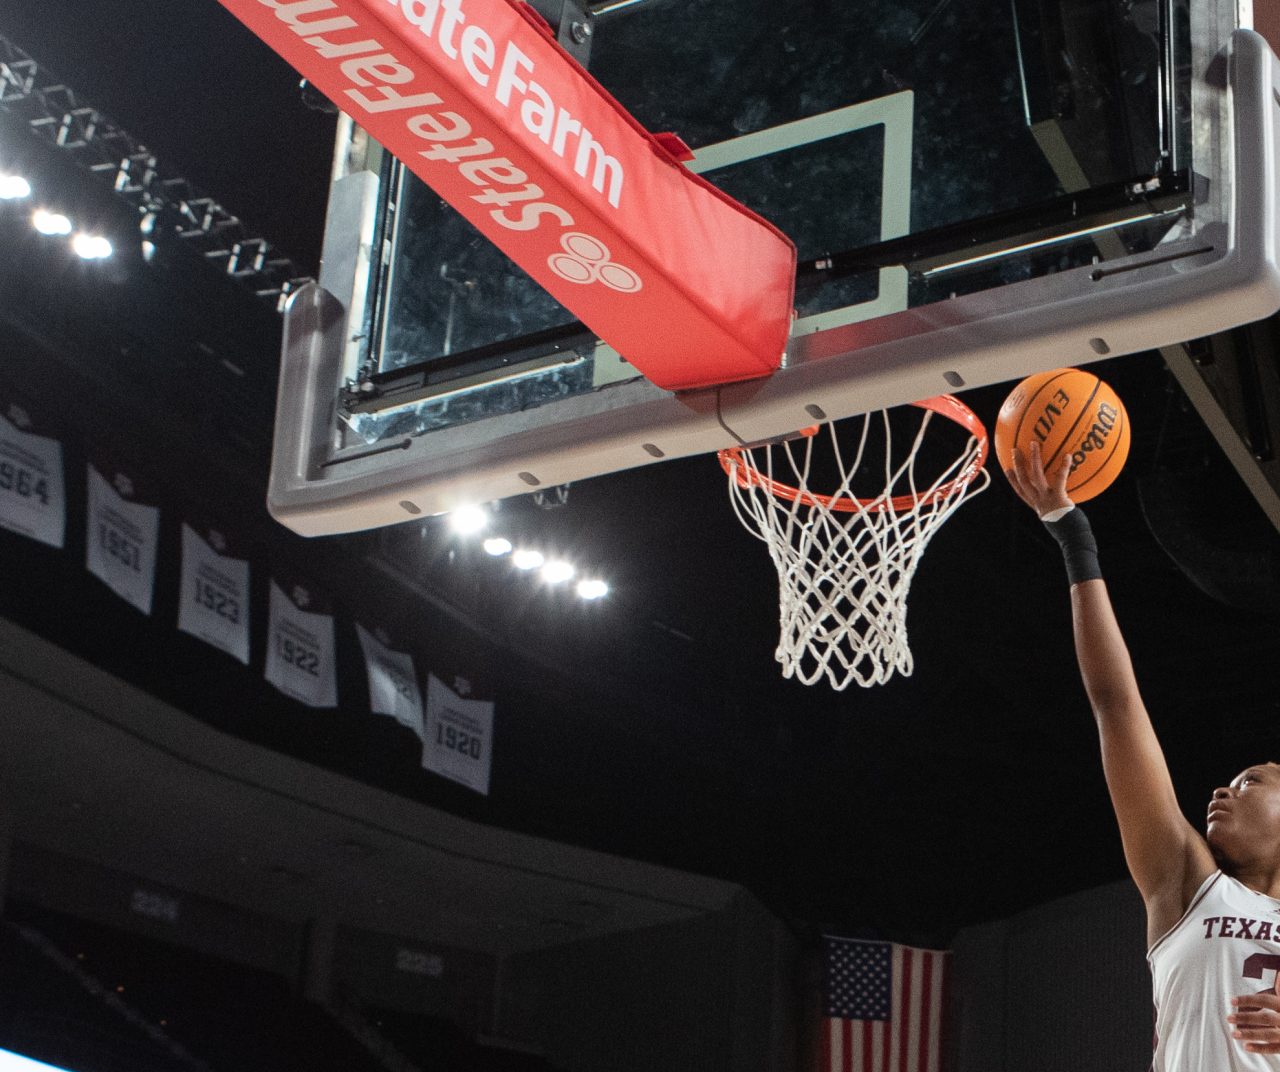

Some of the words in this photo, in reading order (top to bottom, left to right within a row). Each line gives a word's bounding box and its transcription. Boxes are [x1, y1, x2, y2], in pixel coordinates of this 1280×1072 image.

[388, 0, 624, 208] ateFarm
[0, 462, 49, 506] 964
[435, 721, 482, 760] 1920
